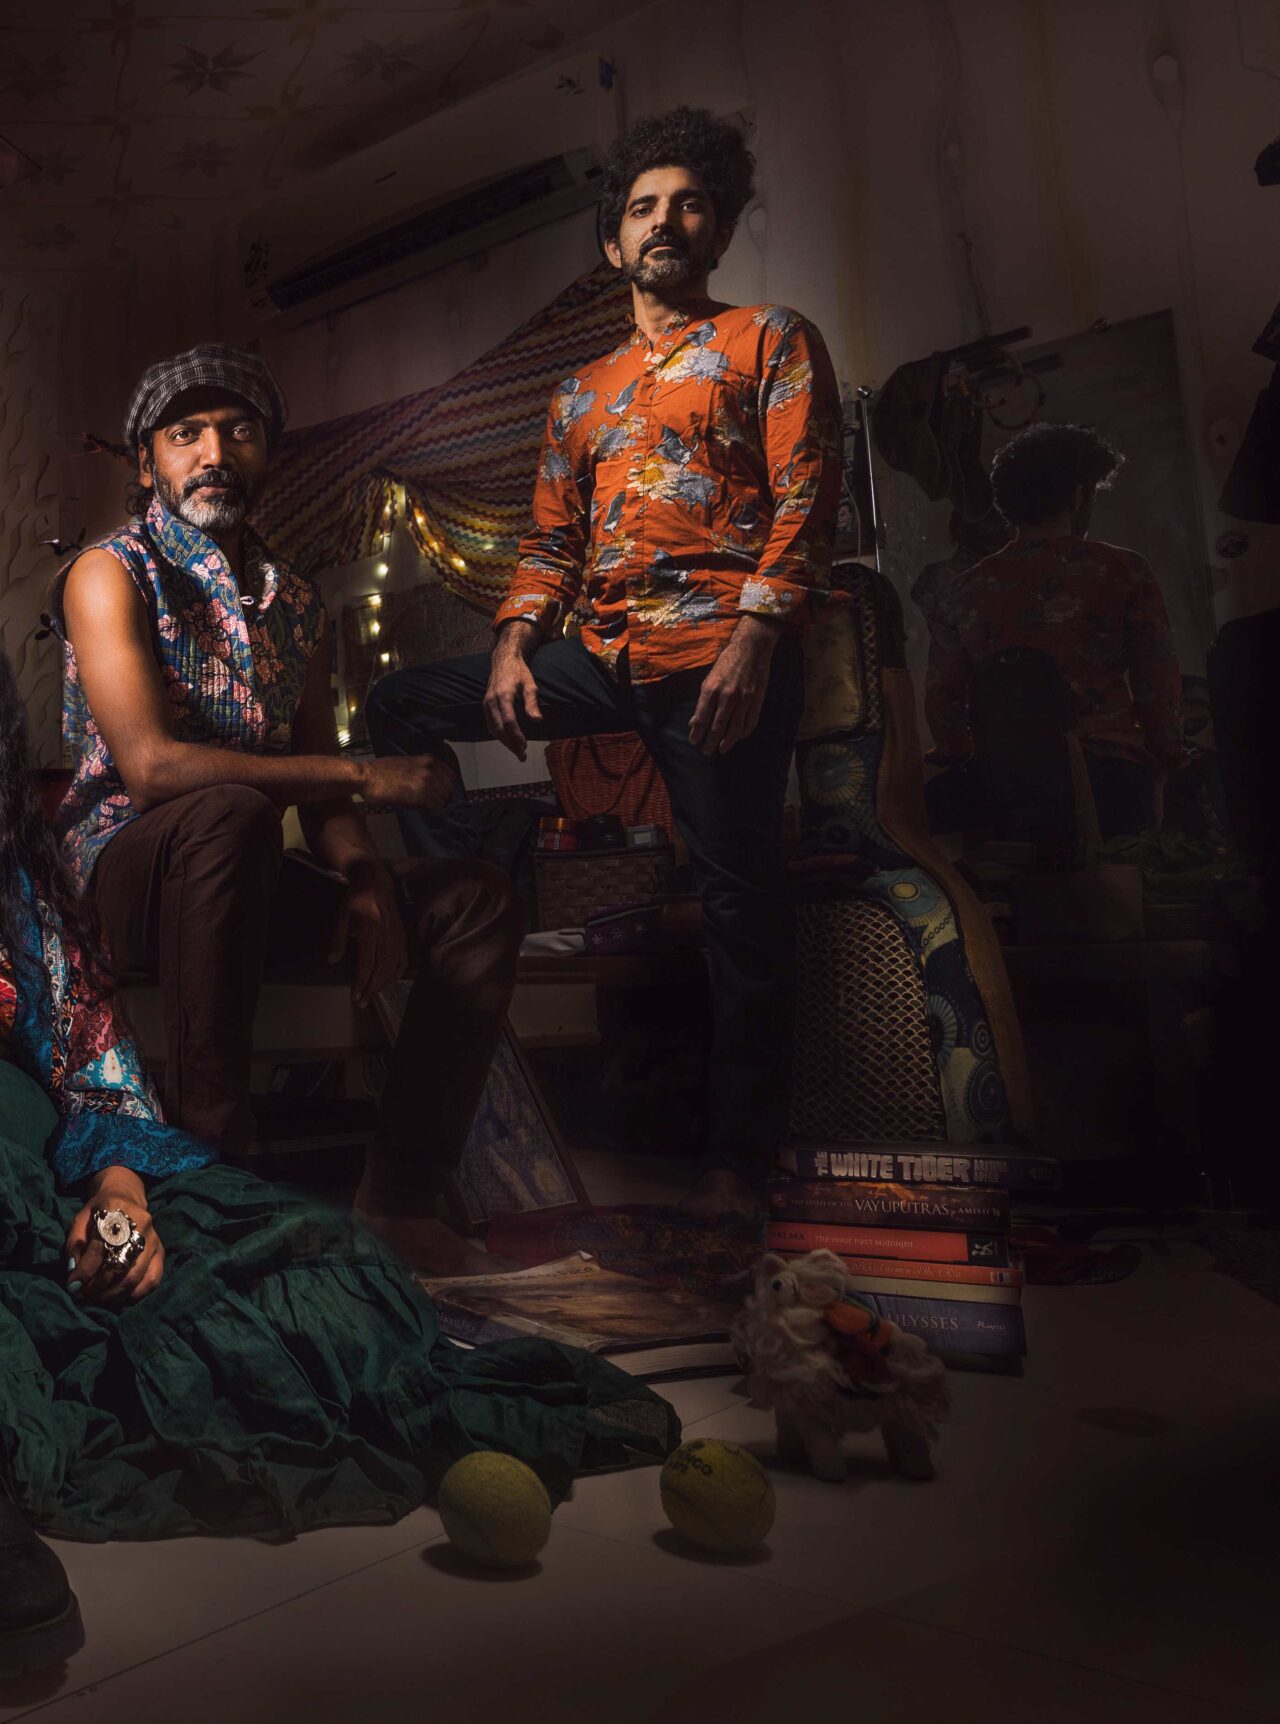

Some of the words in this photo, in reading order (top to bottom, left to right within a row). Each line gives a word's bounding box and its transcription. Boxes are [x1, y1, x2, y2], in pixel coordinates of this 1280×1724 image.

[855, 1199, 949, 1216] VAYUPUTRAS
[958, 1207, 991, 1217] AMISH
[887, 1313, 959, 1331] ULYSSES
